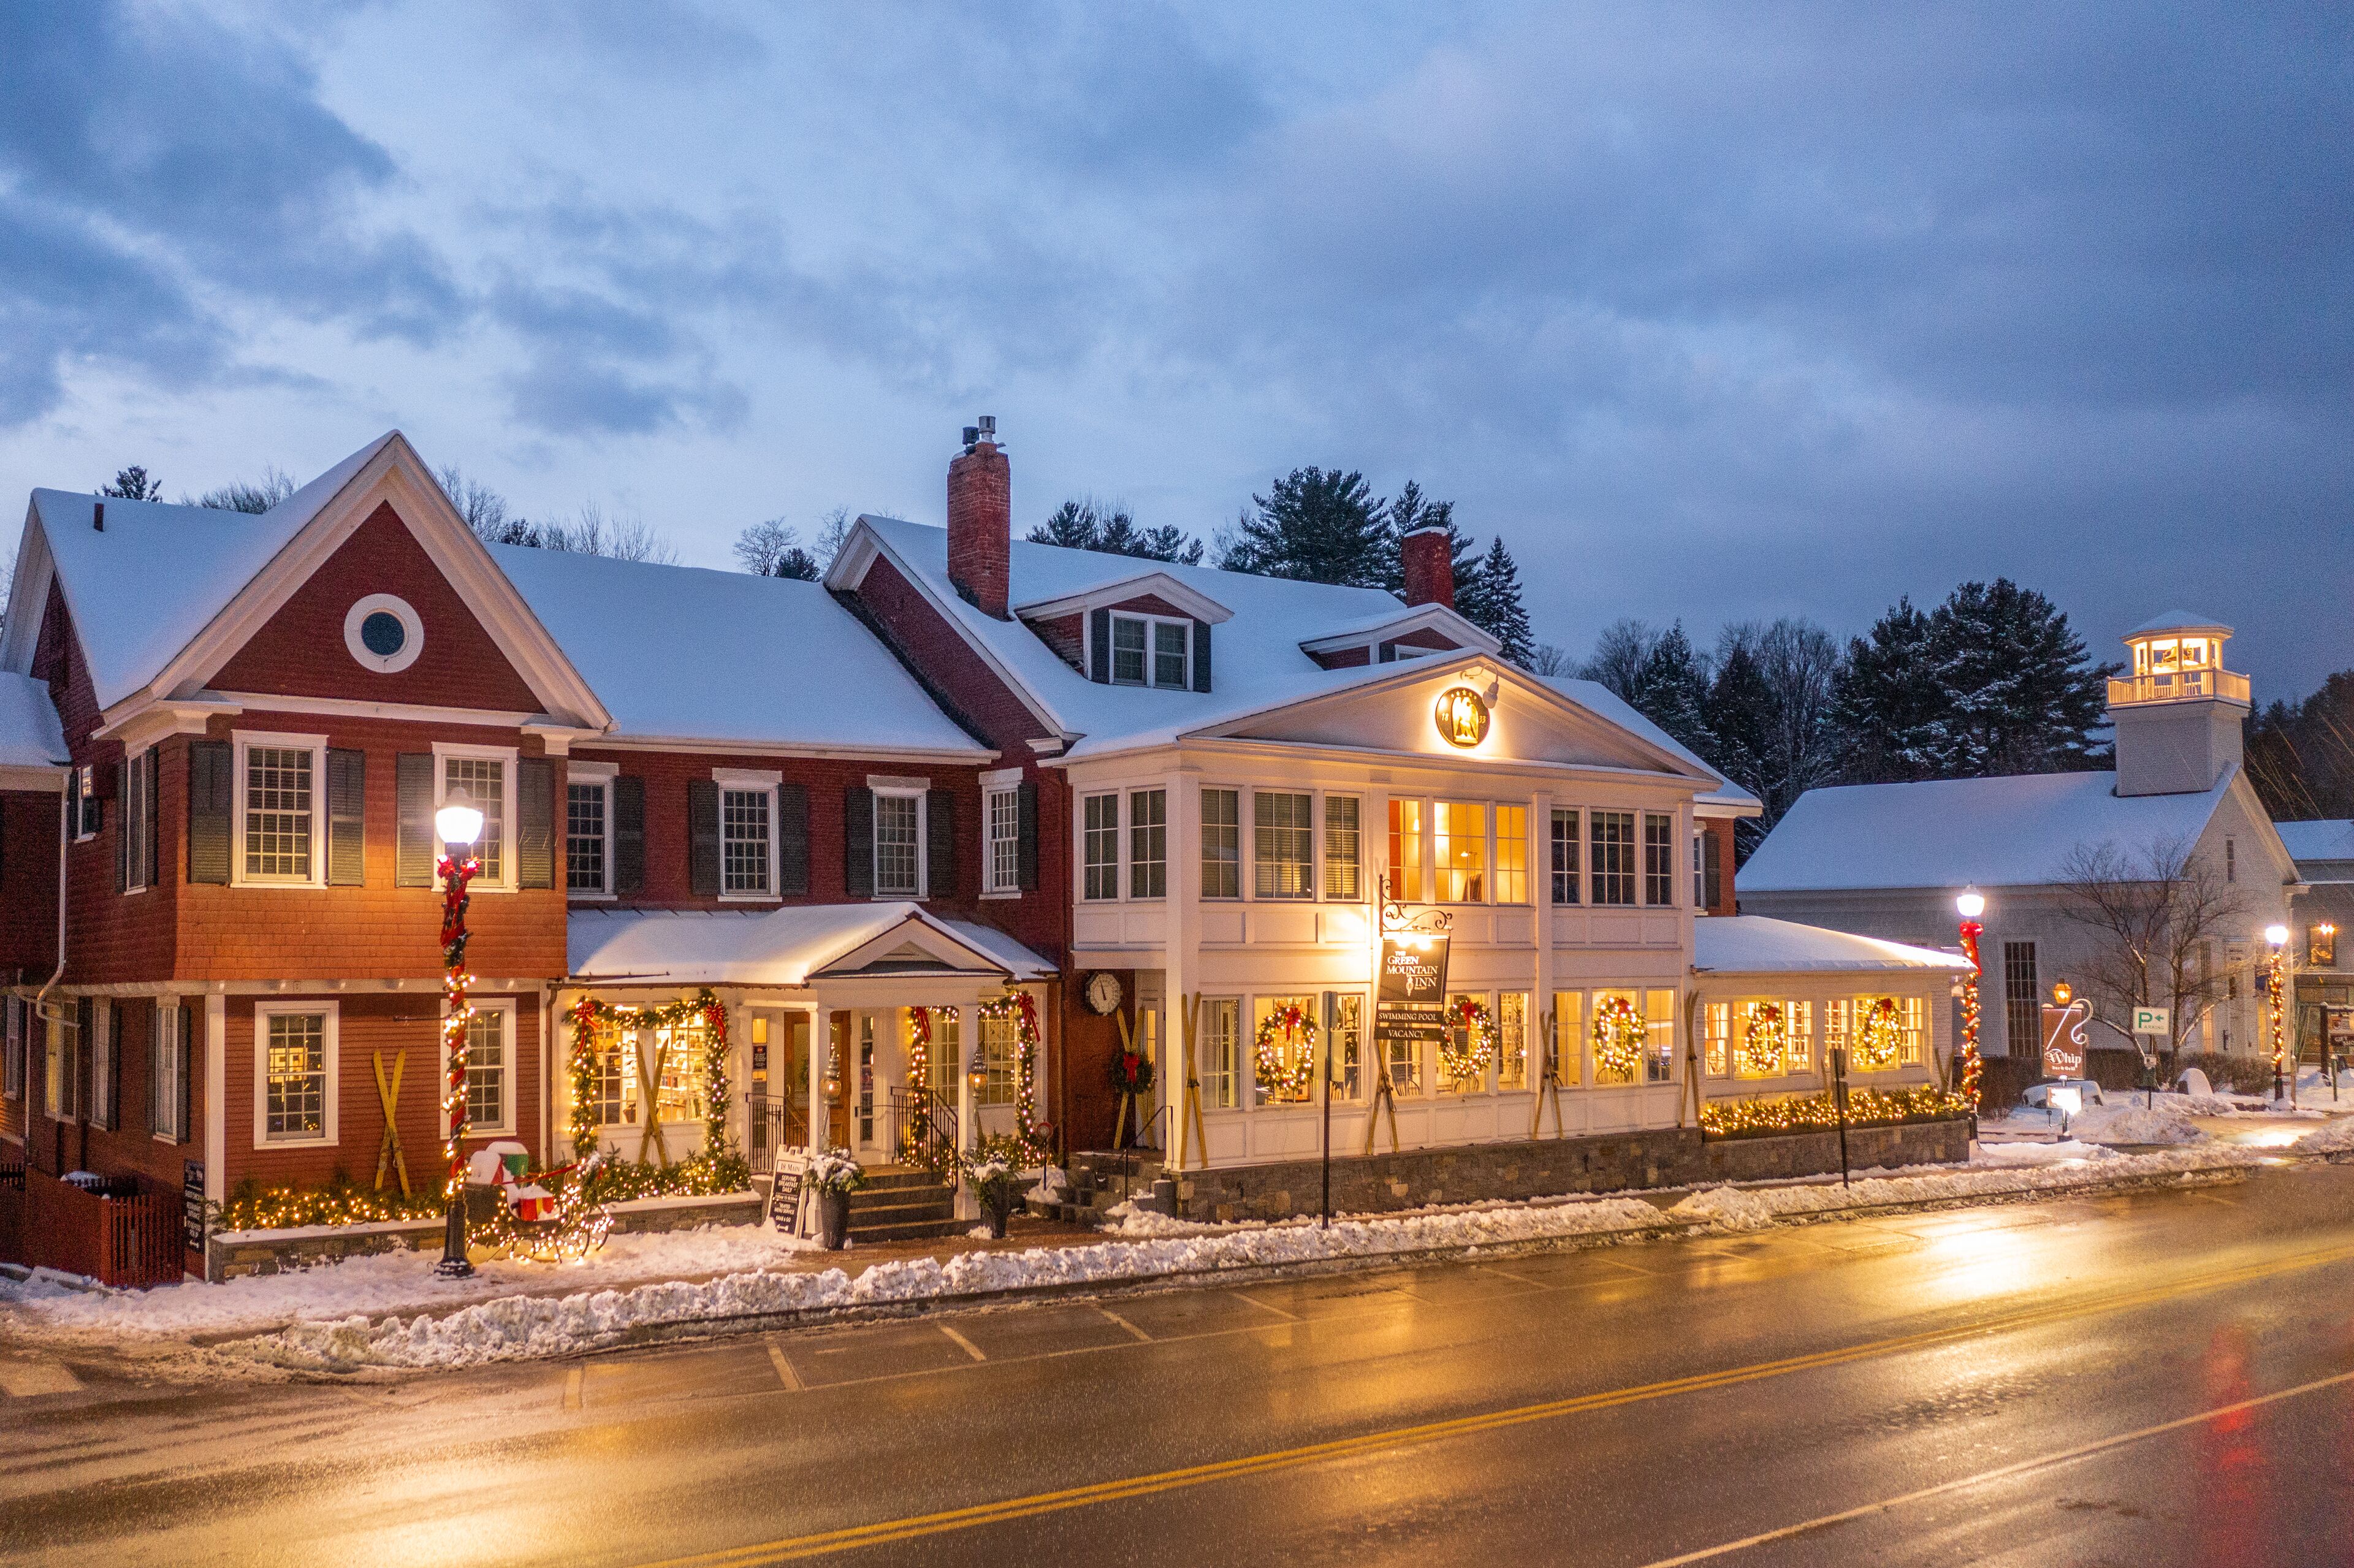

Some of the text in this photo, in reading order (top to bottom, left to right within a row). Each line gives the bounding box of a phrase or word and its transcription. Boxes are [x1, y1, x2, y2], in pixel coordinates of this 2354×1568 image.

[1441, 713, 1449, 721] 18
[1387, 956, 1420, 965] GREEN
[1386, 965, 1438, 975] MOUNTAIN
[1415, 977, 1438, 987] INN
[1388, 1029, 1425, 1038] VACANCY
[2044, 1048, 2081, 1068] Whip
